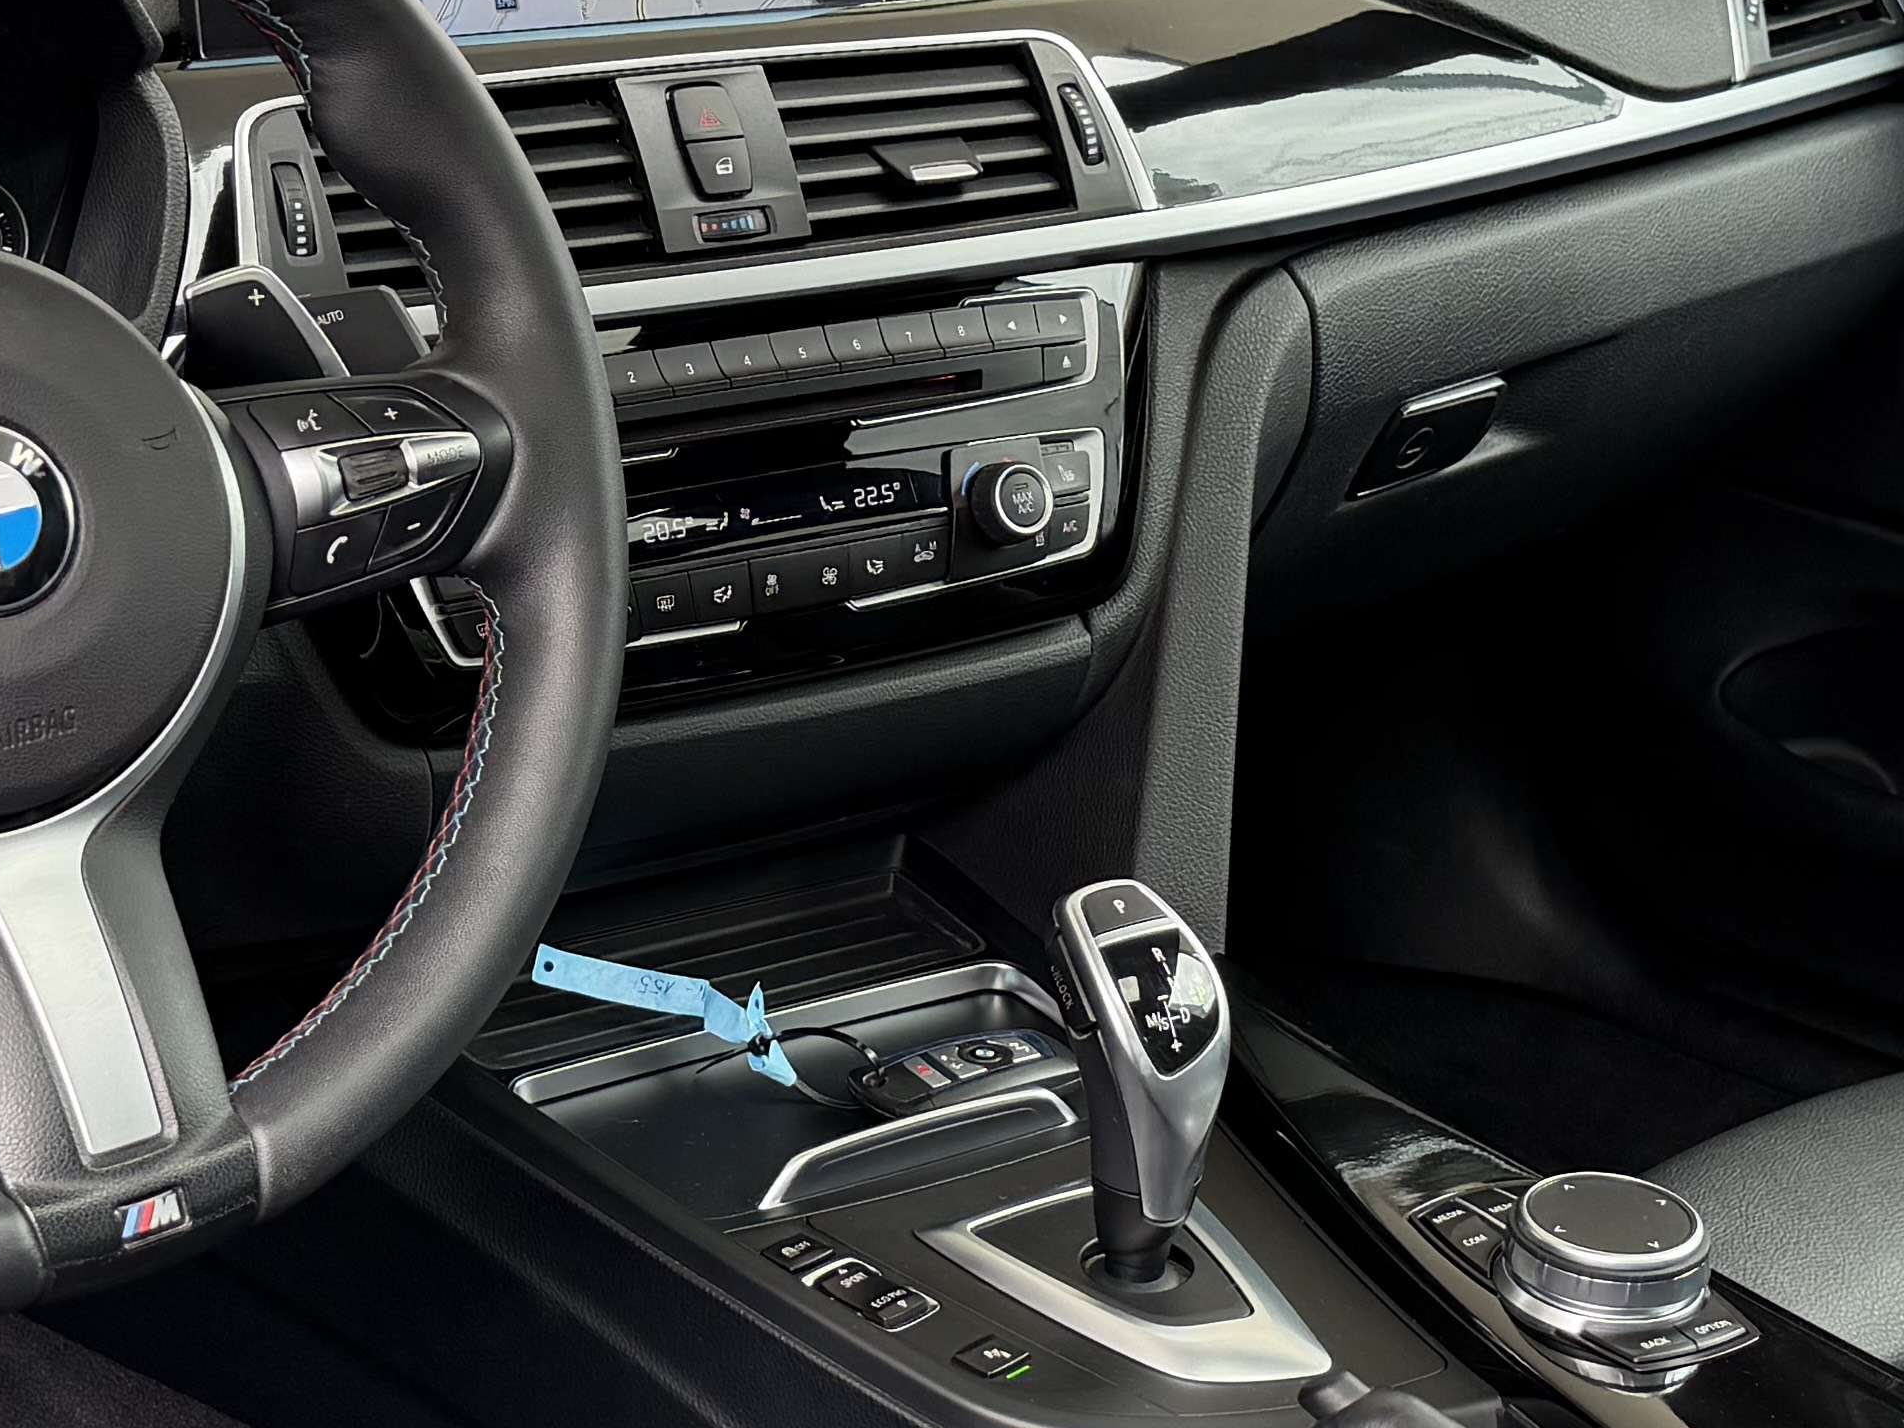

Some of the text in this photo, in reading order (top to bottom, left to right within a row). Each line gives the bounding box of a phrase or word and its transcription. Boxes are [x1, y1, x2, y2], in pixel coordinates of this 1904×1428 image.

[316, 309, 345, 325] AUTO
[627, 324, 966, 383] 2 3 4 5 6 7 8
[426, 444, 466, 466] MODE
[1011, 491, 1035, 504] MAX
[1017, 502, 1035, 515] A/C
[1062, 520, 1078, 533] A/C
[1112, 899, 1125, 914] P
[1151, 947, 1166, 962] R
[1179, 1007, 1191, 1025] D
[1432, 1209, 1467, 1224] MEDIA
[1462, 1234, 1489, 1247] COM
[839, 1272, 869, 1288] SPORT
[1694, 1319, 1733, 1334] OPTION
[1639, 1336, 1672, 1350] BACK
